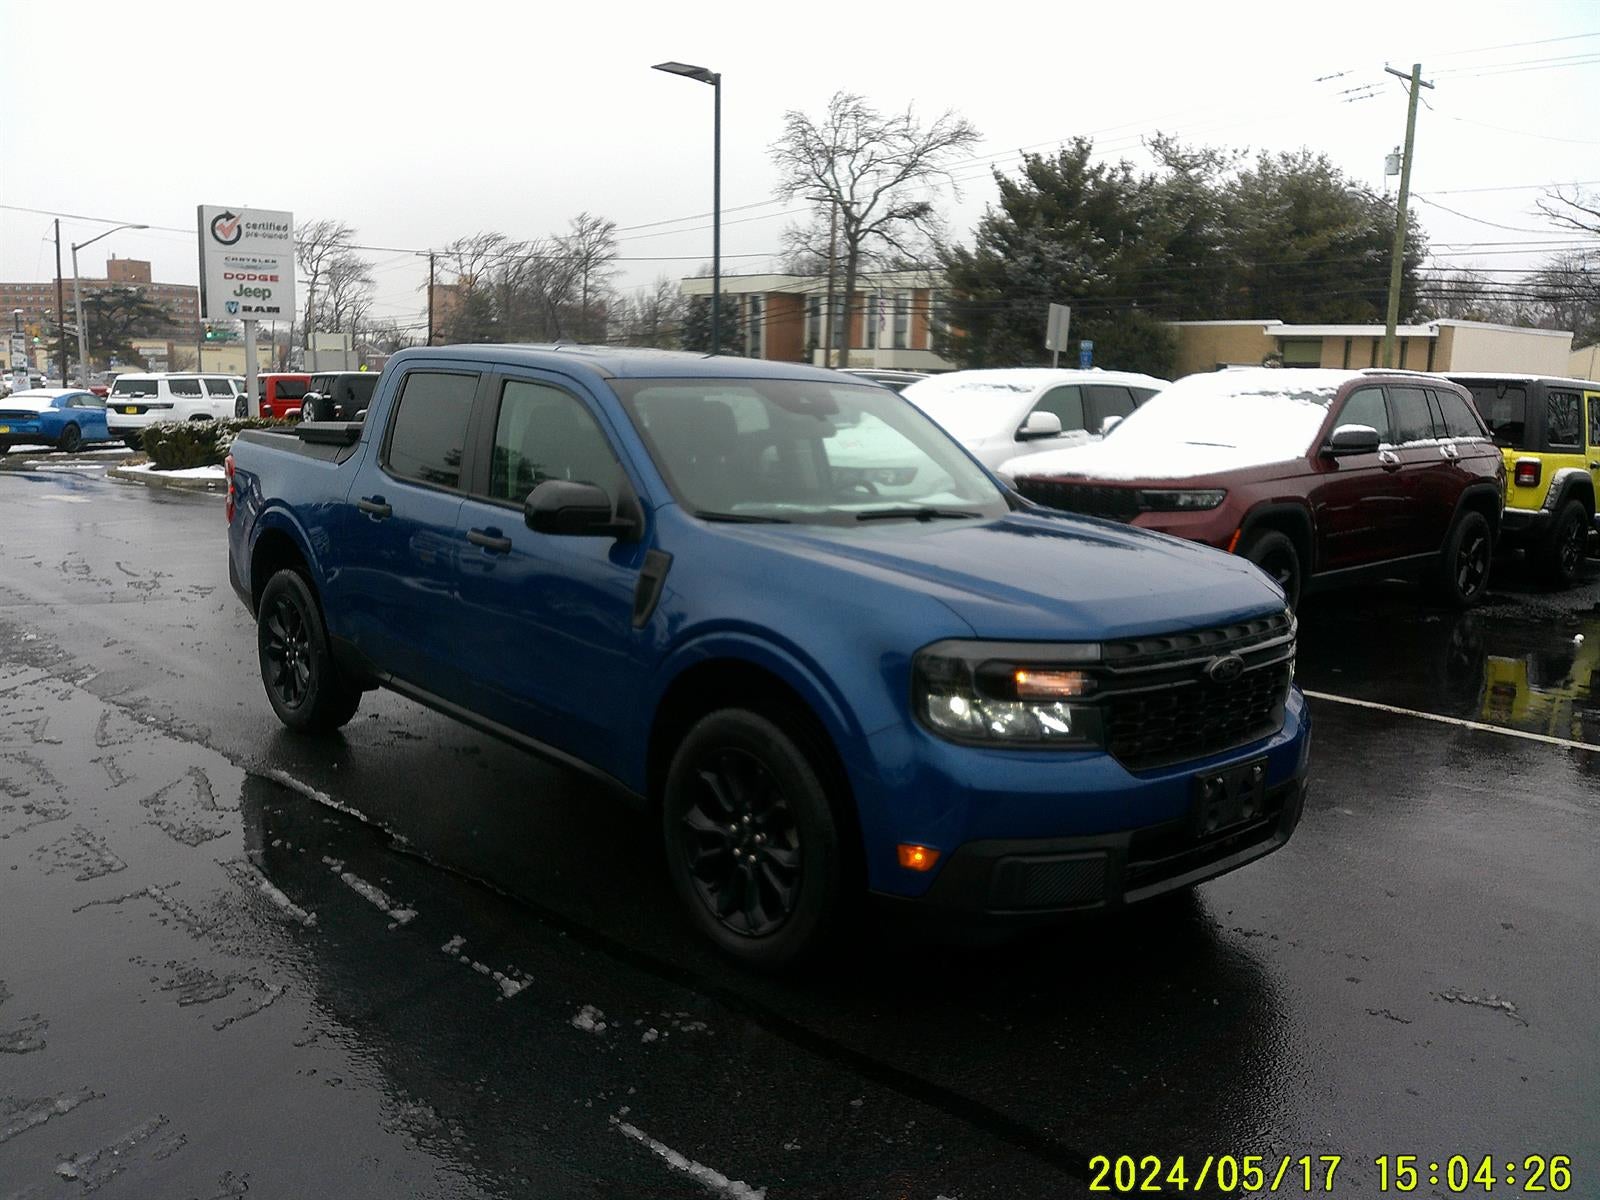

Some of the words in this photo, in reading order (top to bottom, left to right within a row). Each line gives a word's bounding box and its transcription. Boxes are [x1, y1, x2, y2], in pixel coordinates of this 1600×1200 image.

[245, 222, 288, 231] certified
[245, 231, 288, 240] pre-owned
[223, 272, 279, 282] DODGE
[233, 283, 272, 301] Jeep
[242, 305, 280, 313] RAM
